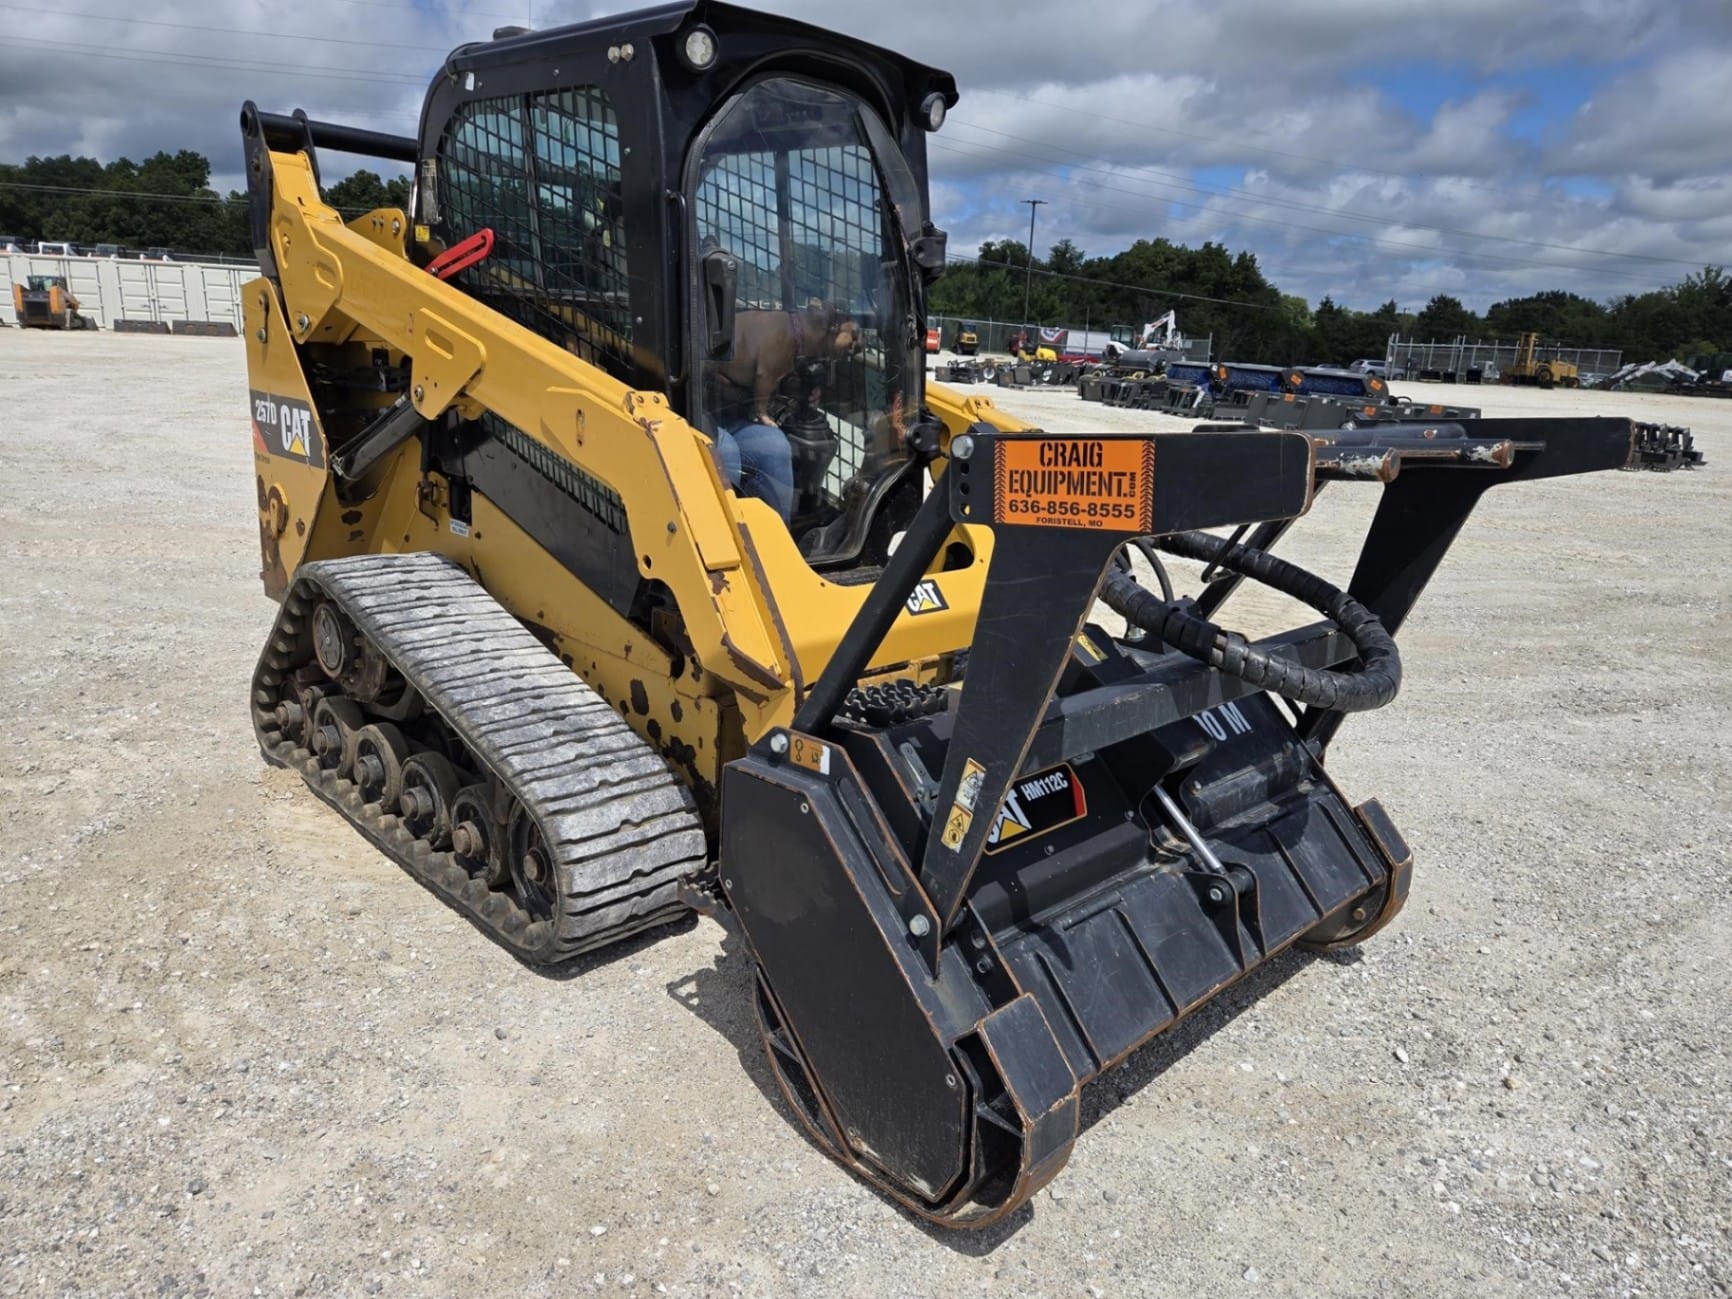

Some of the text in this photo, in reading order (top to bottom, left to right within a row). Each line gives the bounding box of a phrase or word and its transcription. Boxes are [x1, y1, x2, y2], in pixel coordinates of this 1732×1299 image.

[256, 399, 311, 457] 257D CAT
[1040, 442, 1103, 468] CRAIG
[1008, 499, 1136, 519] 636-856-8555
[1036, 516, 1103, 528] FORISTELL, MO
[1020, 771, 1069, 802] HM112C
